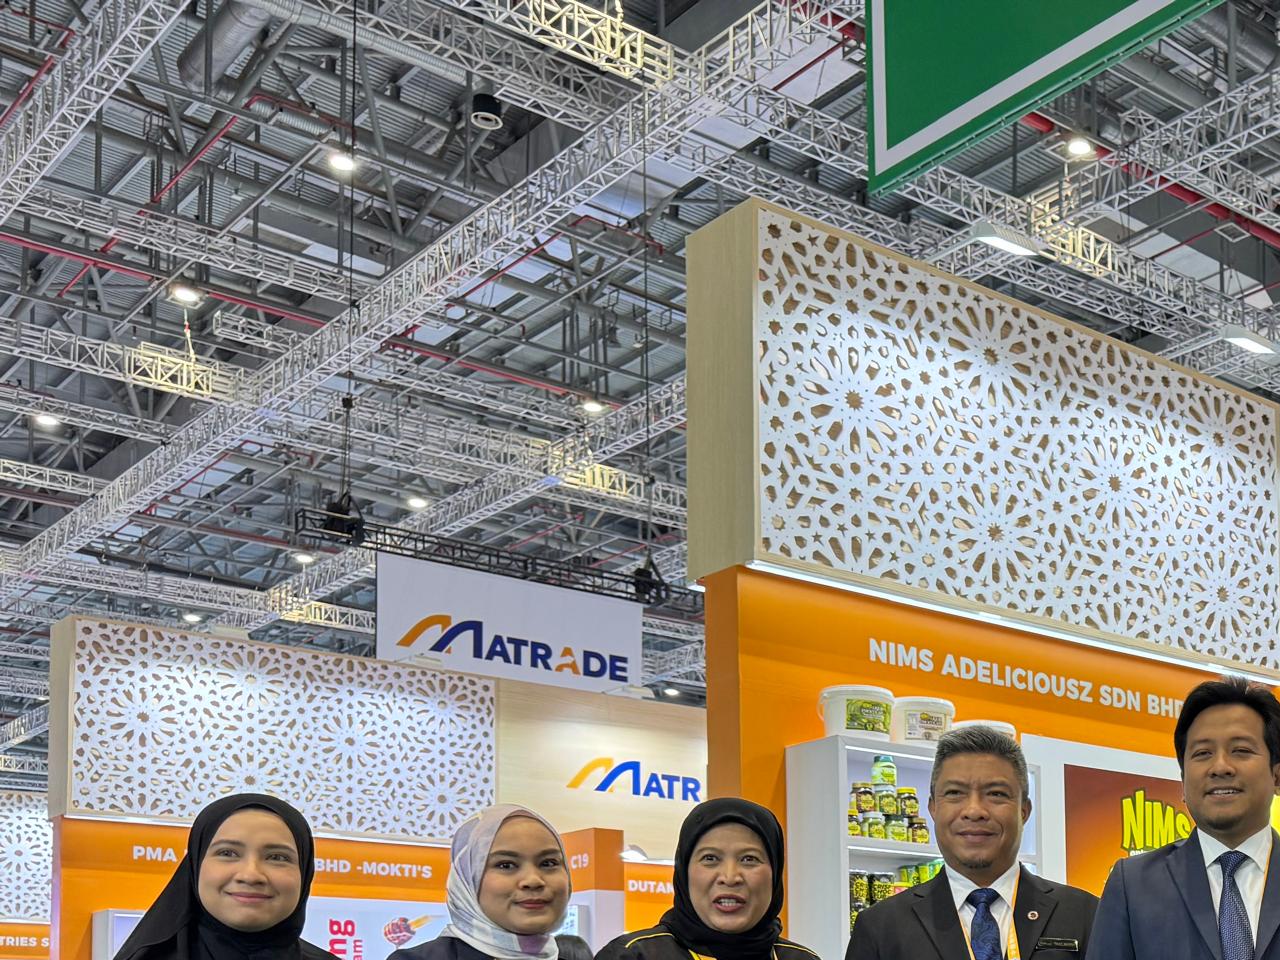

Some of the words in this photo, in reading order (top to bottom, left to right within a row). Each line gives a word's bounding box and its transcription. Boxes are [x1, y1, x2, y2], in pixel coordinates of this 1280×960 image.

[396, 614, 629, 683] MATRADE
[868, 637, 933, 672] NIMS
[941, 654, 1093, 703] ADELICIOUSZ
[1099, 685, 1141, 712] SDN
[1122, 789, 1192, 849] NIMS
[132, 845, 177, 862] PMA
[356, 862, 432, 879] -MOKTI'S
[570, 853, 589, 870] C19
